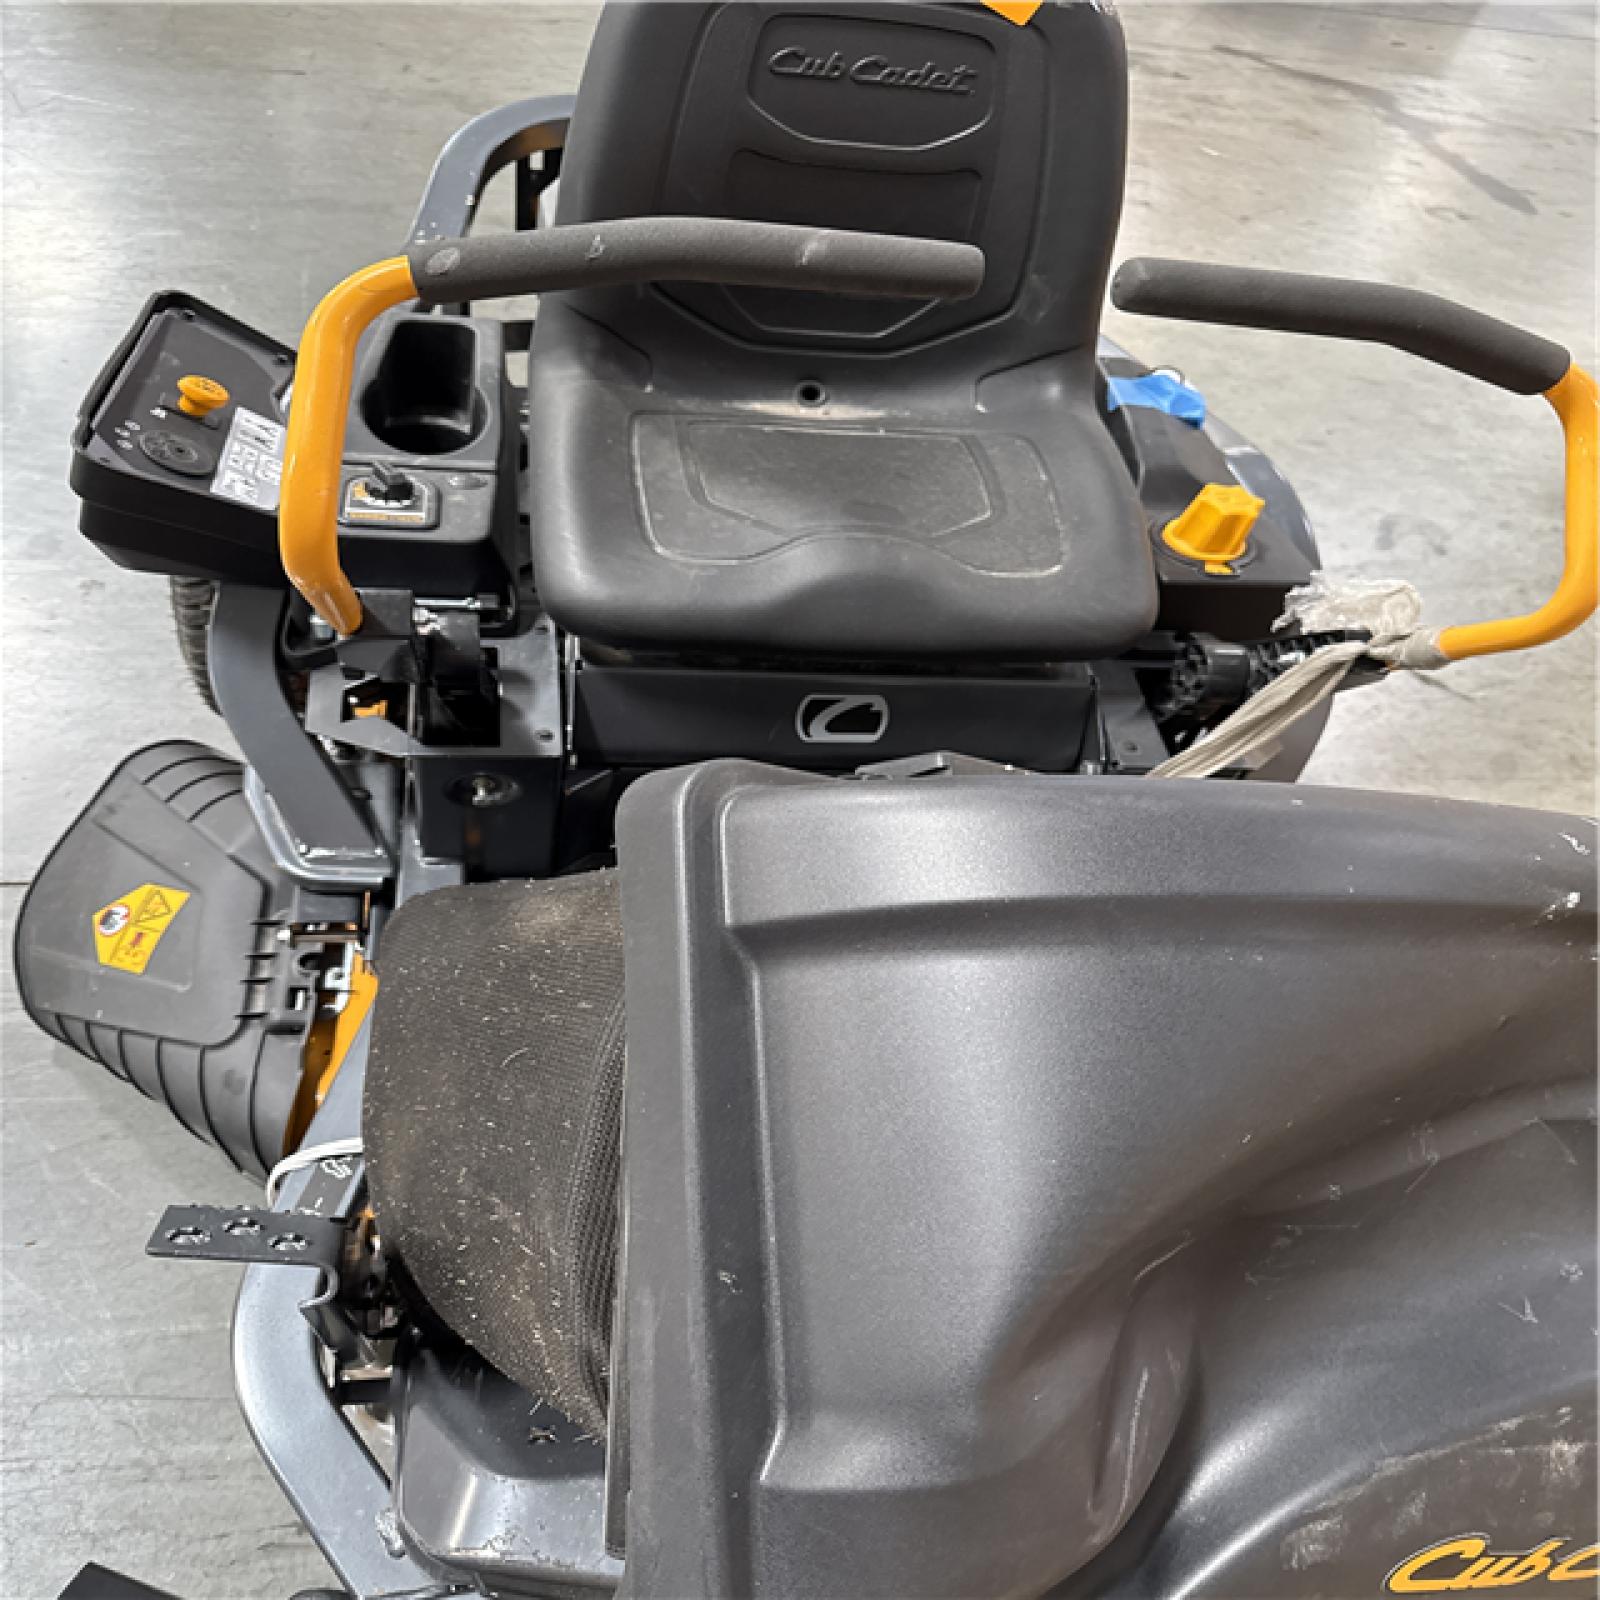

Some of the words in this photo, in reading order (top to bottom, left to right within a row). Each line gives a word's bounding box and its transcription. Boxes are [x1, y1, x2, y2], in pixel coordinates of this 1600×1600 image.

[768, 46, 846, 77] Cub
[849, 54, 978, 94] Cadet
[1386, 1536, 1566, 1593] Cub
